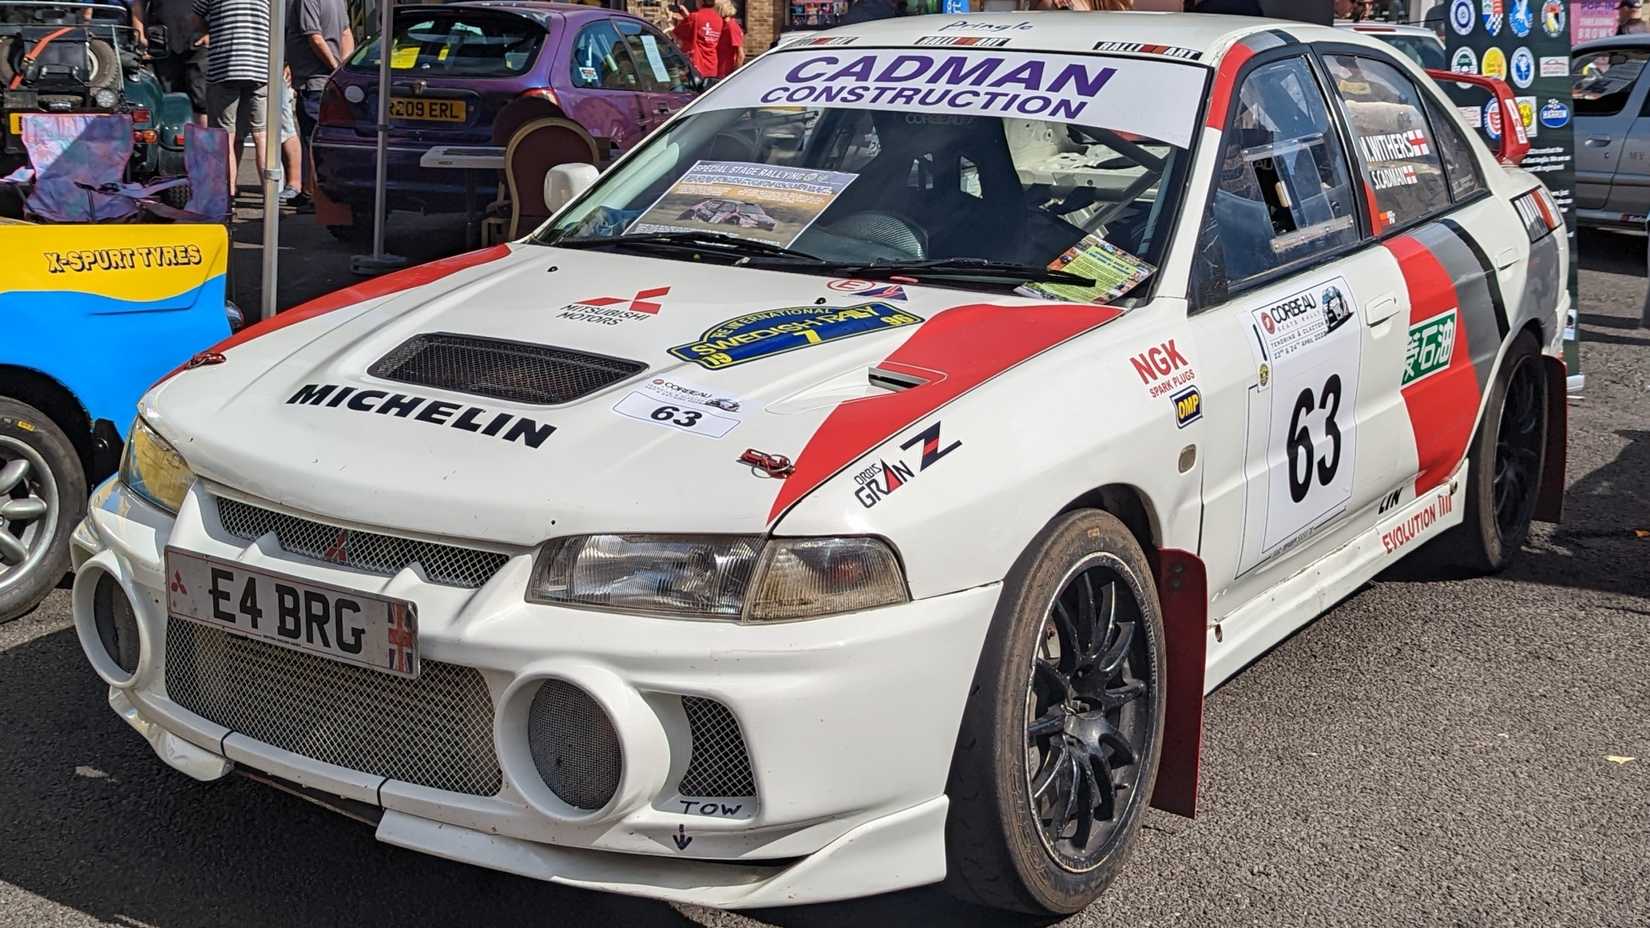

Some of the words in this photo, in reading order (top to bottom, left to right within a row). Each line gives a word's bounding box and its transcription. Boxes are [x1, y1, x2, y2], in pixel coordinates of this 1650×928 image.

[785, 55, 1117, 97] CADMAN
[429, 102, 459, 119] ERL
[760, 86, 1088, 119] CONSTRUCTION
[729, 165, 758, 175] STAGE
[44, 249, 135, 272] X-SPURT
[137, 245, 202, 266] TYRES
[556, 311, 623, 326] MOTORS
[560, 304, 651, 321] MITSUBISHI
[1270, 293, 1316, 324] CORBEAU
[691, 319, 822, 356] SWEDISH
[793, 329, 822, 344] 7
[702, 352, 733, 366] 19
[1129, 339, 1188, 385] NGK
[1150, 380, 1174, 398] SPARK
[1172, 369, 1195, 388] PLUGS
[286, 384, 557, 449] MICHELIN
[651, 406, 703, 427] 63
[1178, 394, 1199, 419] OMP
[1287, 374, 1341, 503] 63
[854, 463, 882, 486] ORBIS
[855, 458, 915, 509] GRAN
[1378, 487, 1403, 515] LIN
[1382, 504, 1436, 554] EVOLUTION
[208, 567, 262, 629] E4
[275, 583, 366, 655] BRG
[680, 800, 742, 815] TOW
